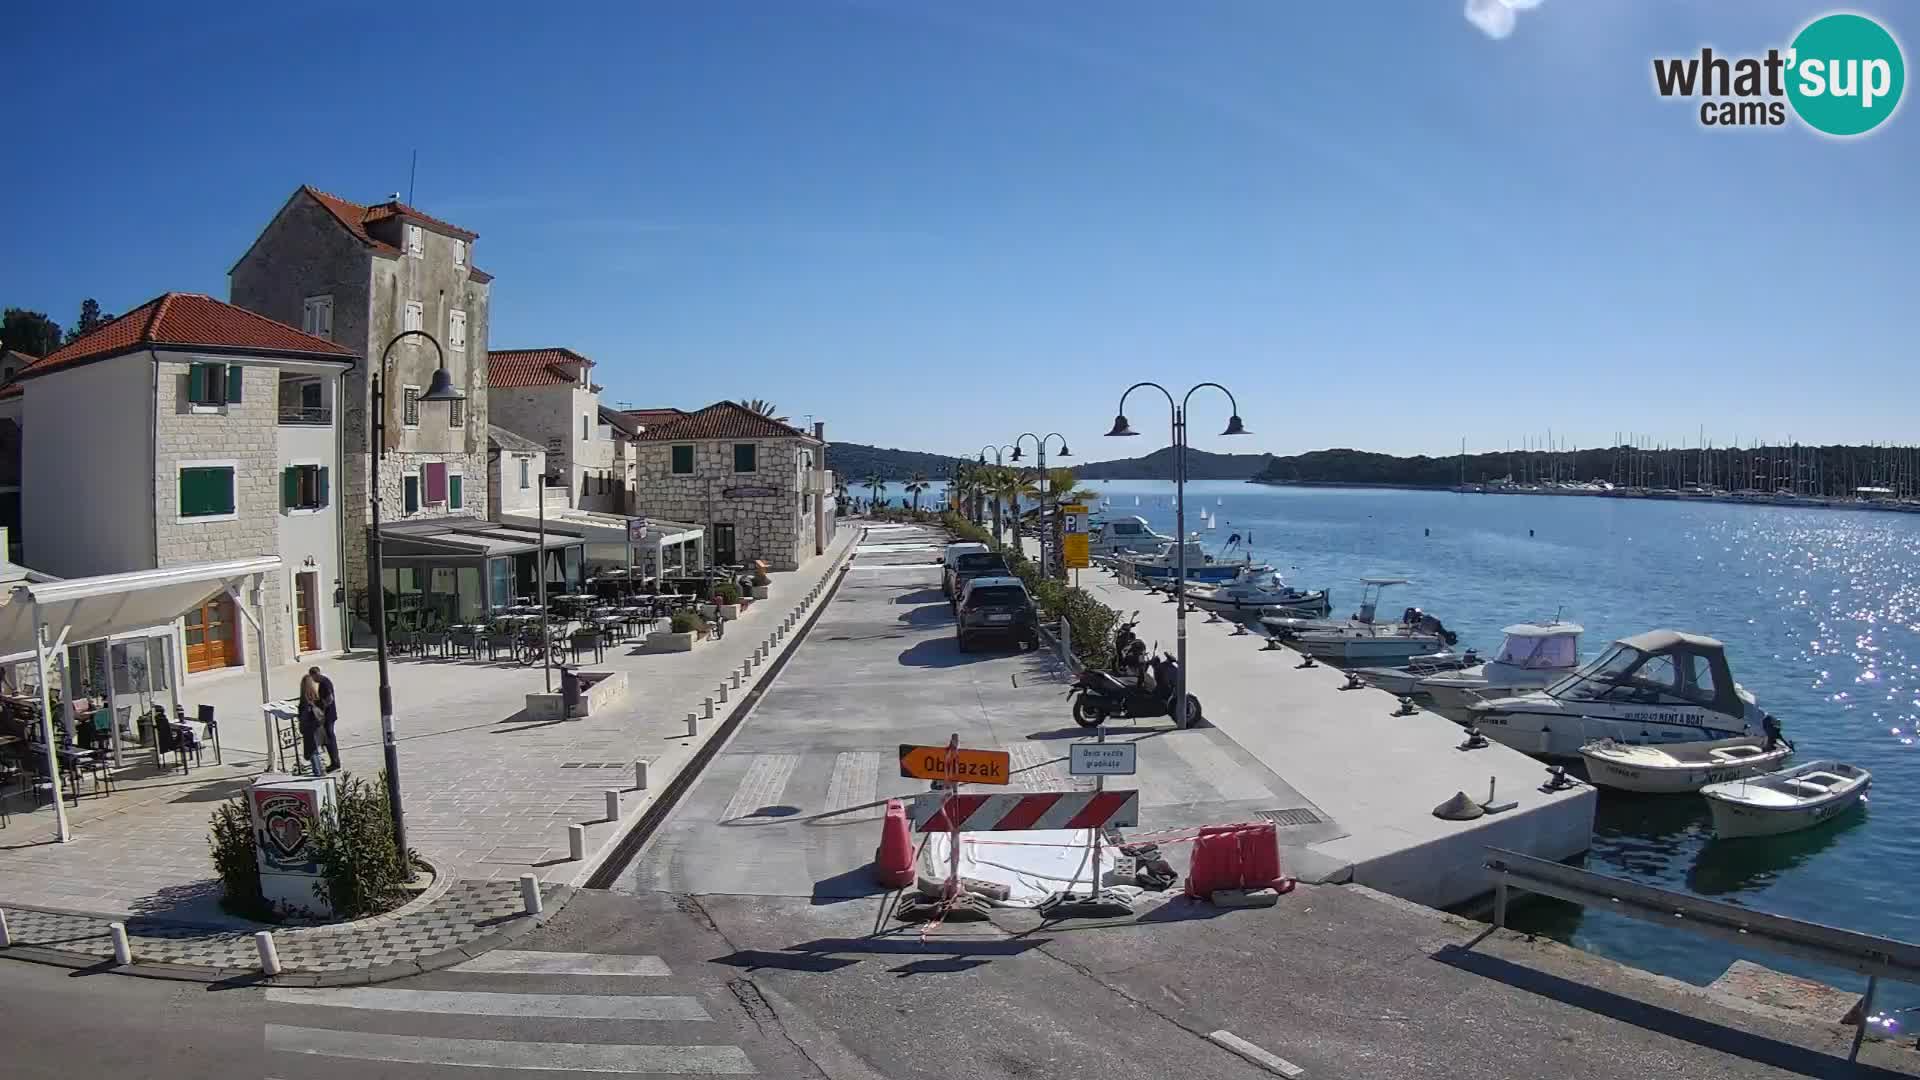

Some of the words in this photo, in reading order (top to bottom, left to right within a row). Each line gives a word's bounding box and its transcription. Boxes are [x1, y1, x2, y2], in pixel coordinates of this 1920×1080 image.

[1065, 515, 1076, 531] P
[1659, 712, 1679, 723] RENT
[1686, 713, 1705, 725] BOAT
